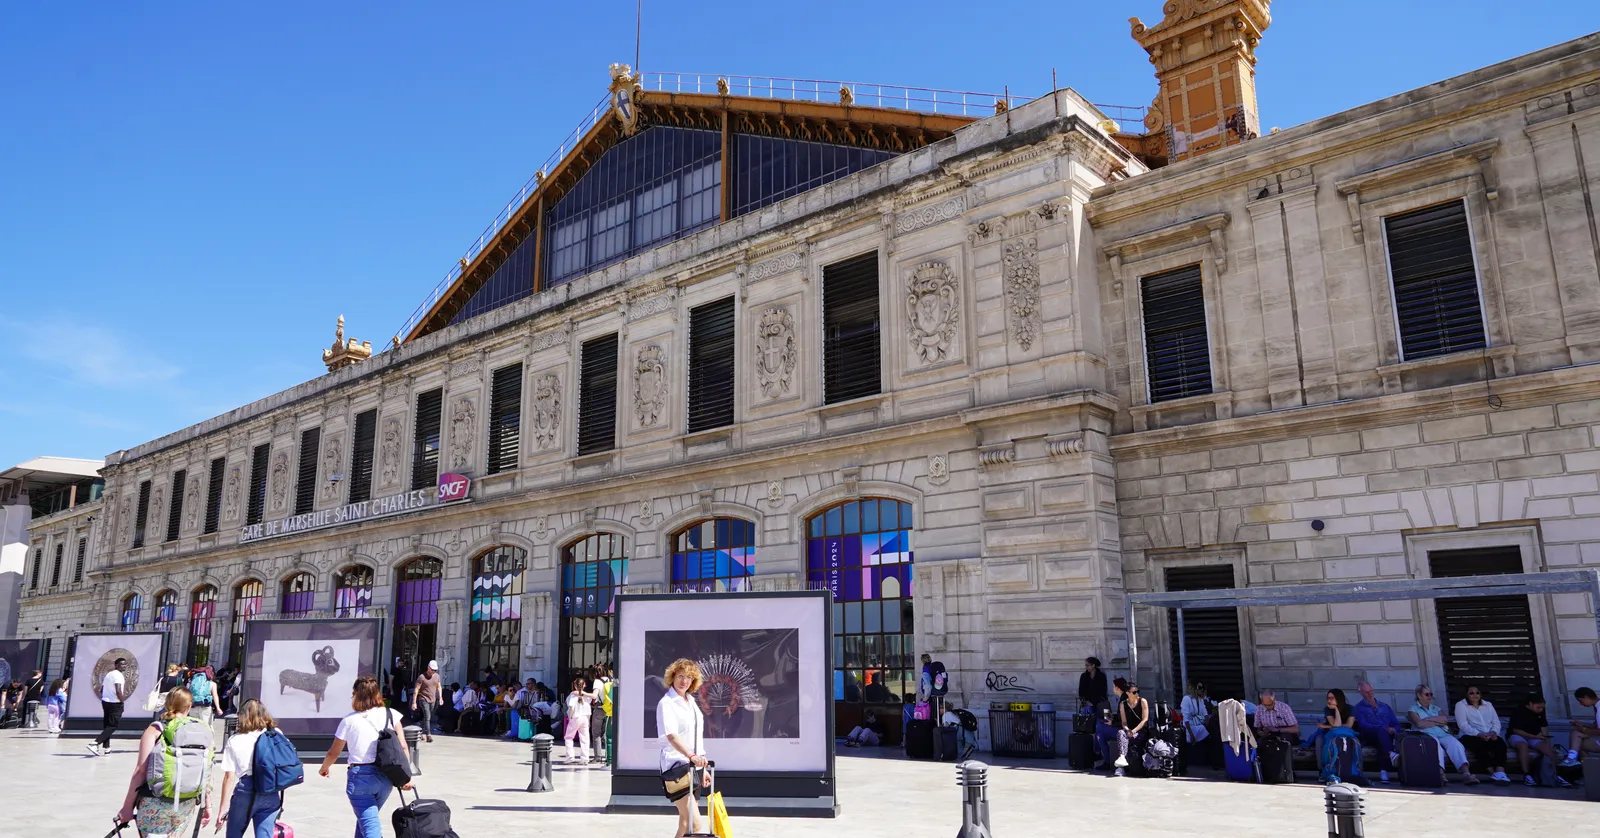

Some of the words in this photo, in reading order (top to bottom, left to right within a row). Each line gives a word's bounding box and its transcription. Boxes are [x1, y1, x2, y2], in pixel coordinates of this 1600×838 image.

[439, 480, 466, 497] SNCF
[241, 524, 263, 541] GARE
[266, 521, 278, 536] DE
[280, 509, 331, 533] MARSEILLE
[335, 500, 369, 523] SAINT
[372, 489, 425, 515] CHARLES
